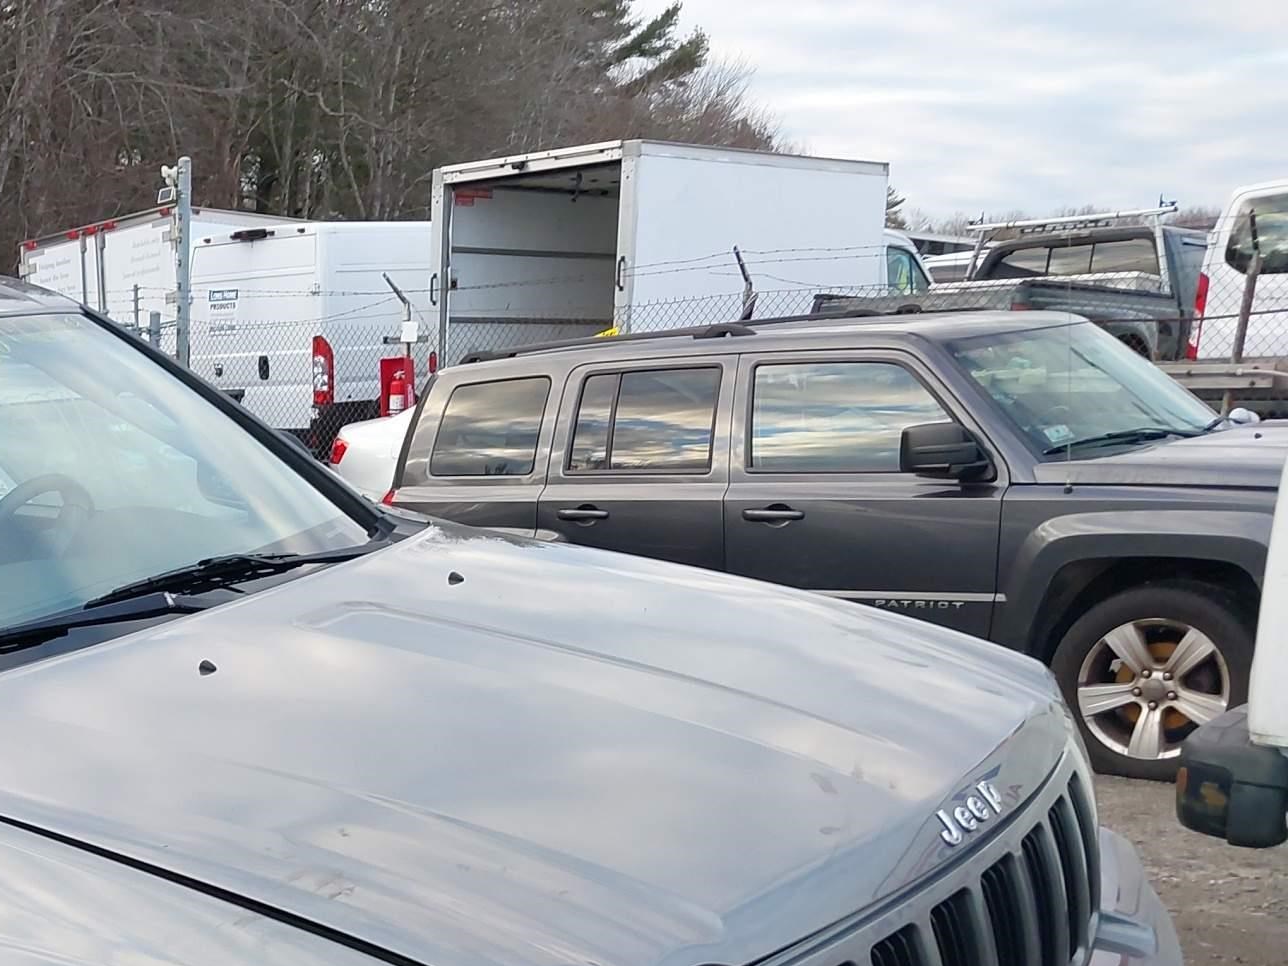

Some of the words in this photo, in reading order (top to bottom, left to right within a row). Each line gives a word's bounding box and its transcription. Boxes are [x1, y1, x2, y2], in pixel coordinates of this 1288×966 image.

[210, 302, 236, 310] PRODUCTS
[874, 599, 965, 609] PATRIOT
[935, 781, 1002, 846] Jeep
